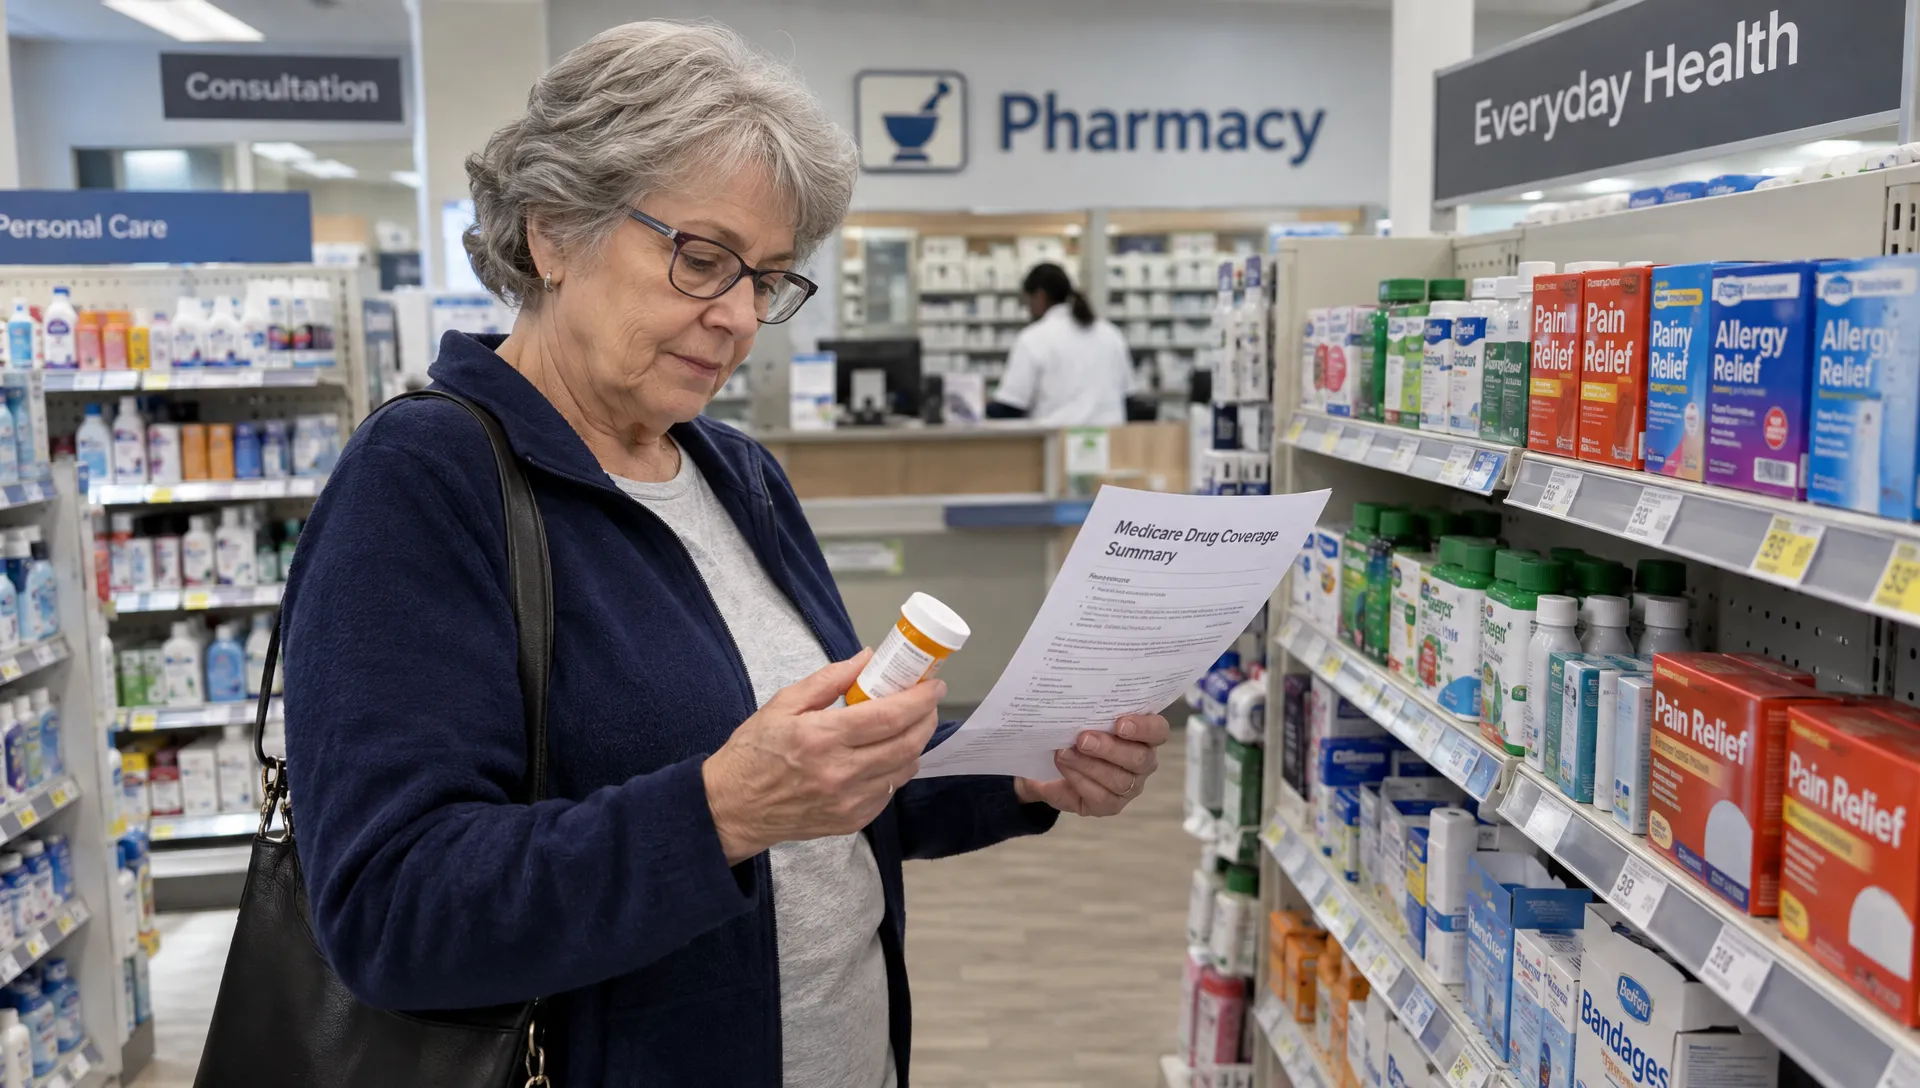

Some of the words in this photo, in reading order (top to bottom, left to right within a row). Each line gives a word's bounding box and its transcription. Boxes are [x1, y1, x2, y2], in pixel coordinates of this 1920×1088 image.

[185, 71, 379, 103] Consultation
[1474, 69, 1632, 141] Everyday
[1644, 9, 1799, 104] Health
[999, 90, 1327, 168] Pharmacy
[0, 213, 103, 239] Personal
[108, 213, 168, 239] Care
[1586, 301, 1625, 333] Pain
[1715, 319, 1788, 358] Allergy
[1820, 318, 1899, 359] Allergy
[1533, 340, 1576, 371] Relief
[1584, 340, 1634, 375] Relief
[1650, 351, 1689, 381] Relief
[1713, 353, 1762, 385] Relief
[1819, 355, 1873, 389] Relief
[1113, 519, 1183, 542] Medicare
[1184, 527, 1220, 547] Drug
[1221, 528, 1279, 546] Coverage
[1105, 541, 1178, 566] Summary
[1654, 689, 1689, 737] Pain
[1691, 708, 1748, 766] Relief
[1788, 751, 1829, 810] Pain
[1831, 775, 1907, 849] Relief
[1617, 873, 1634, 897] 38
[1581, 988, 1669, 1088] Bandages
